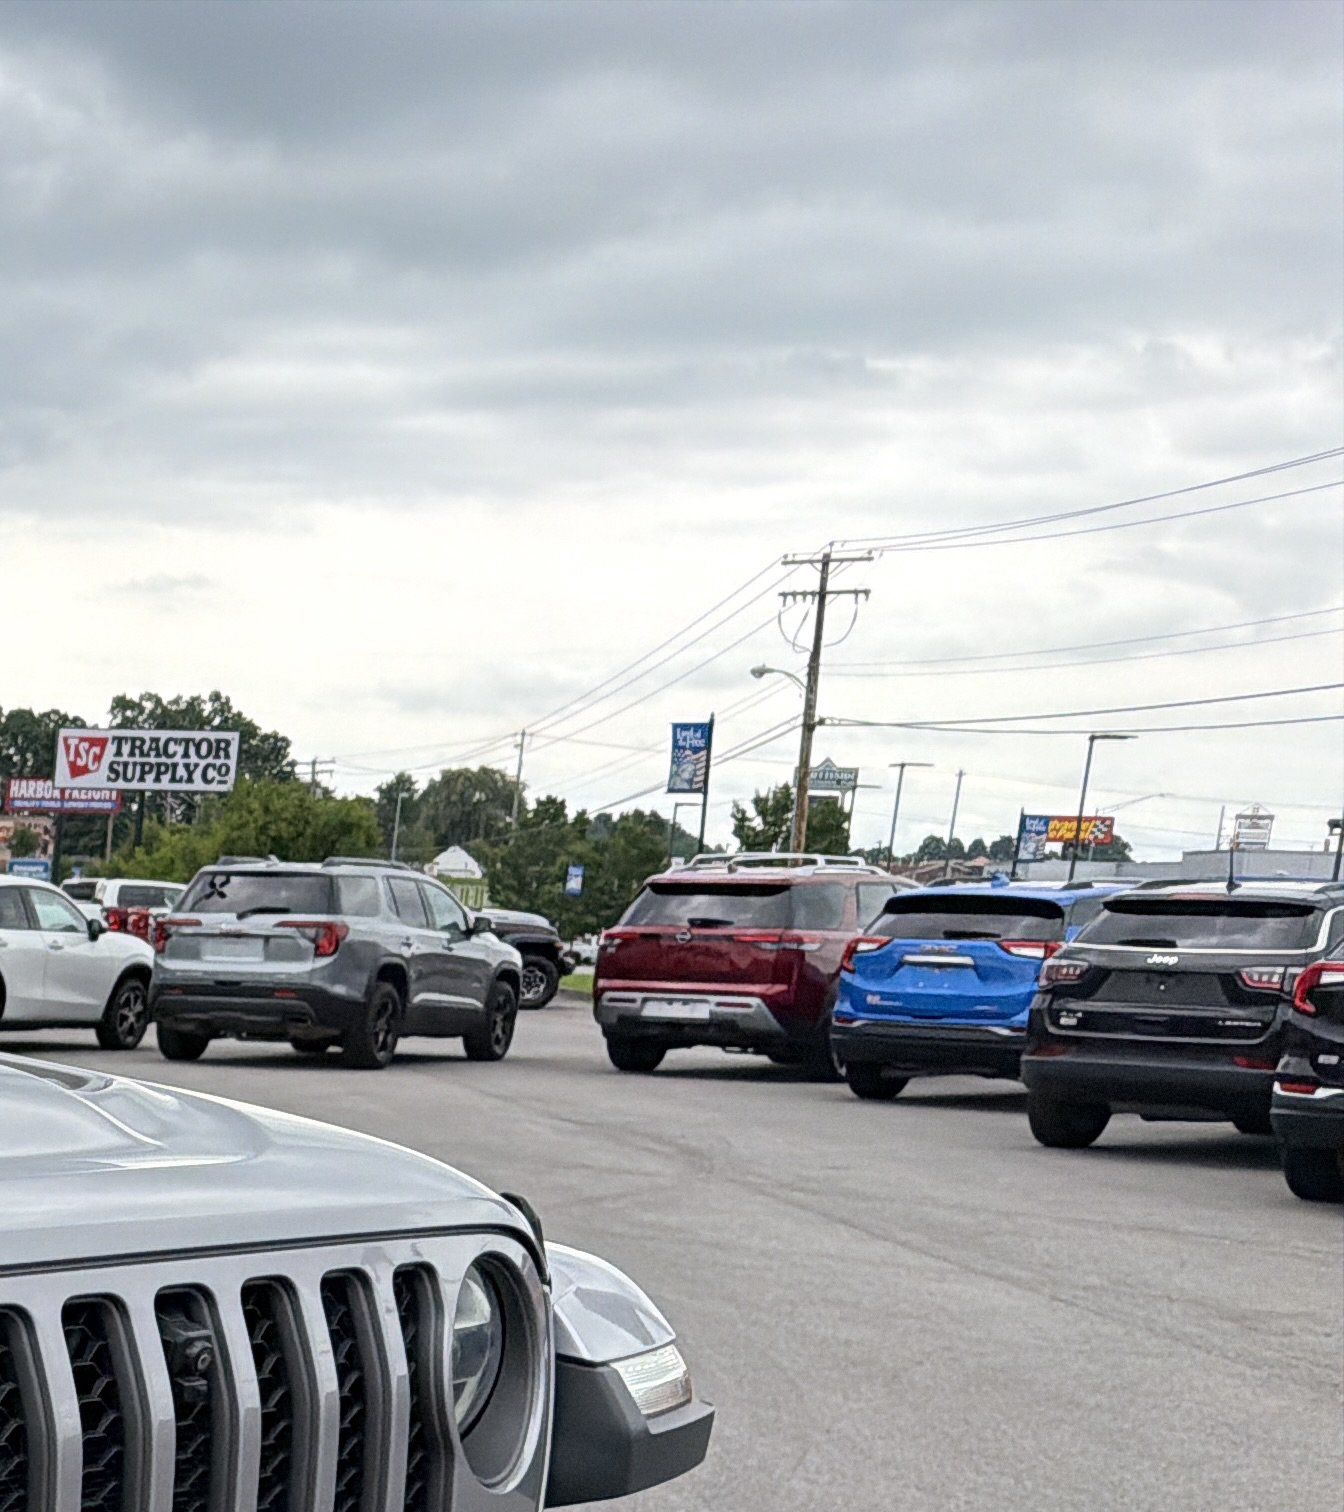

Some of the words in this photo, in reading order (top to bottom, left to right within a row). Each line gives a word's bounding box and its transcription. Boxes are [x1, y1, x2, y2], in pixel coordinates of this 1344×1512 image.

[66, 737, 101, 771] TSC
[112, 736, 231, 760] TRACTOR
[106, 760, 199, 784] SUPPLY
[1146, 953, 1179, 966] Jeep
